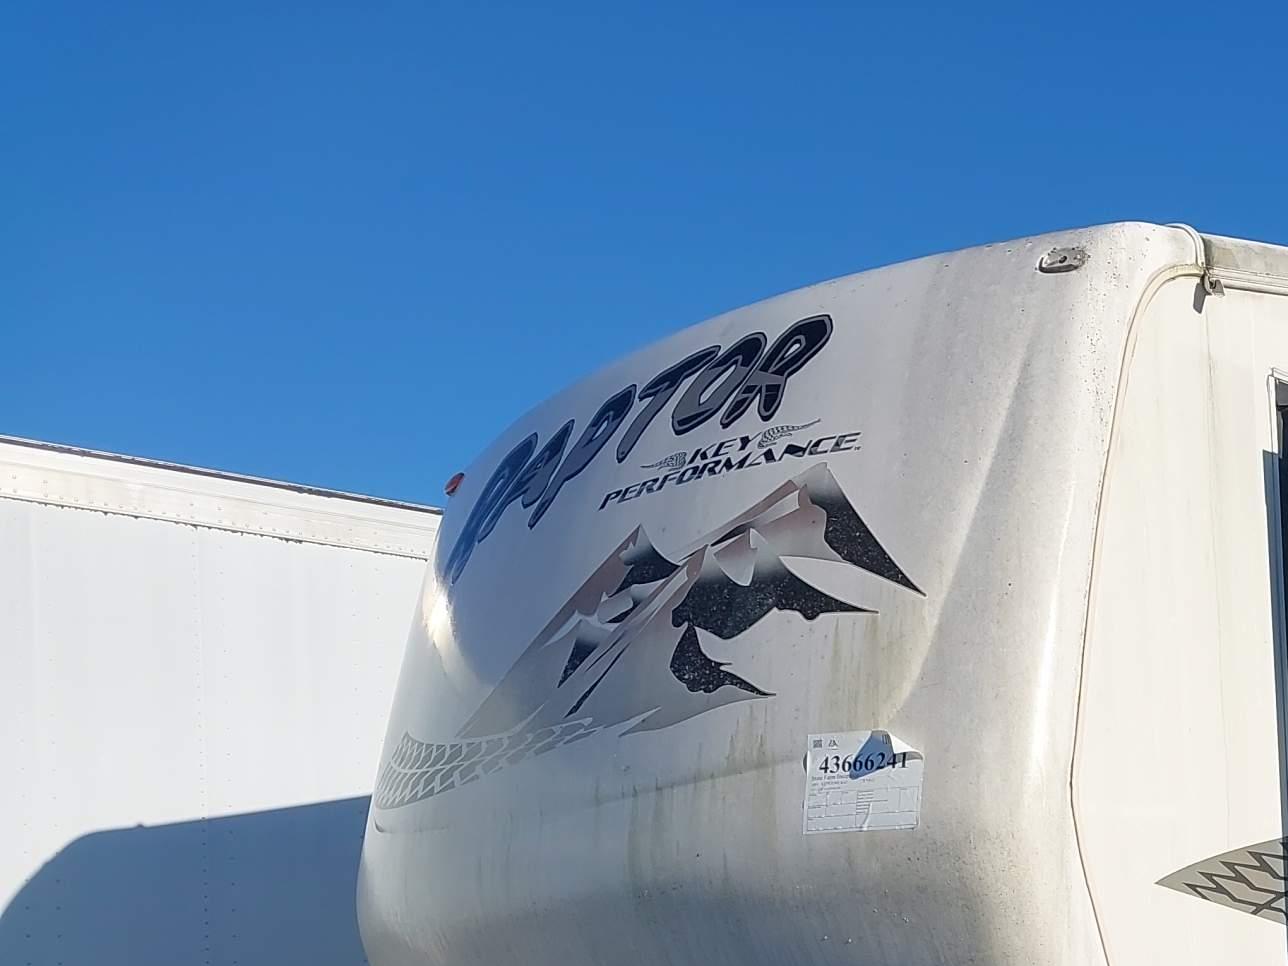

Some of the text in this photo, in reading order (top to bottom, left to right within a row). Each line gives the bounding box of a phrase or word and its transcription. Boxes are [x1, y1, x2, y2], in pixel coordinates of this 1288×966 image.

[444, 314, 833, 585] RAPTOR
[598, 431, 862, 511] PERFORMANCE
[687, 431, 763, 465] KEY
[819, 751, 909, 774] 43666241
